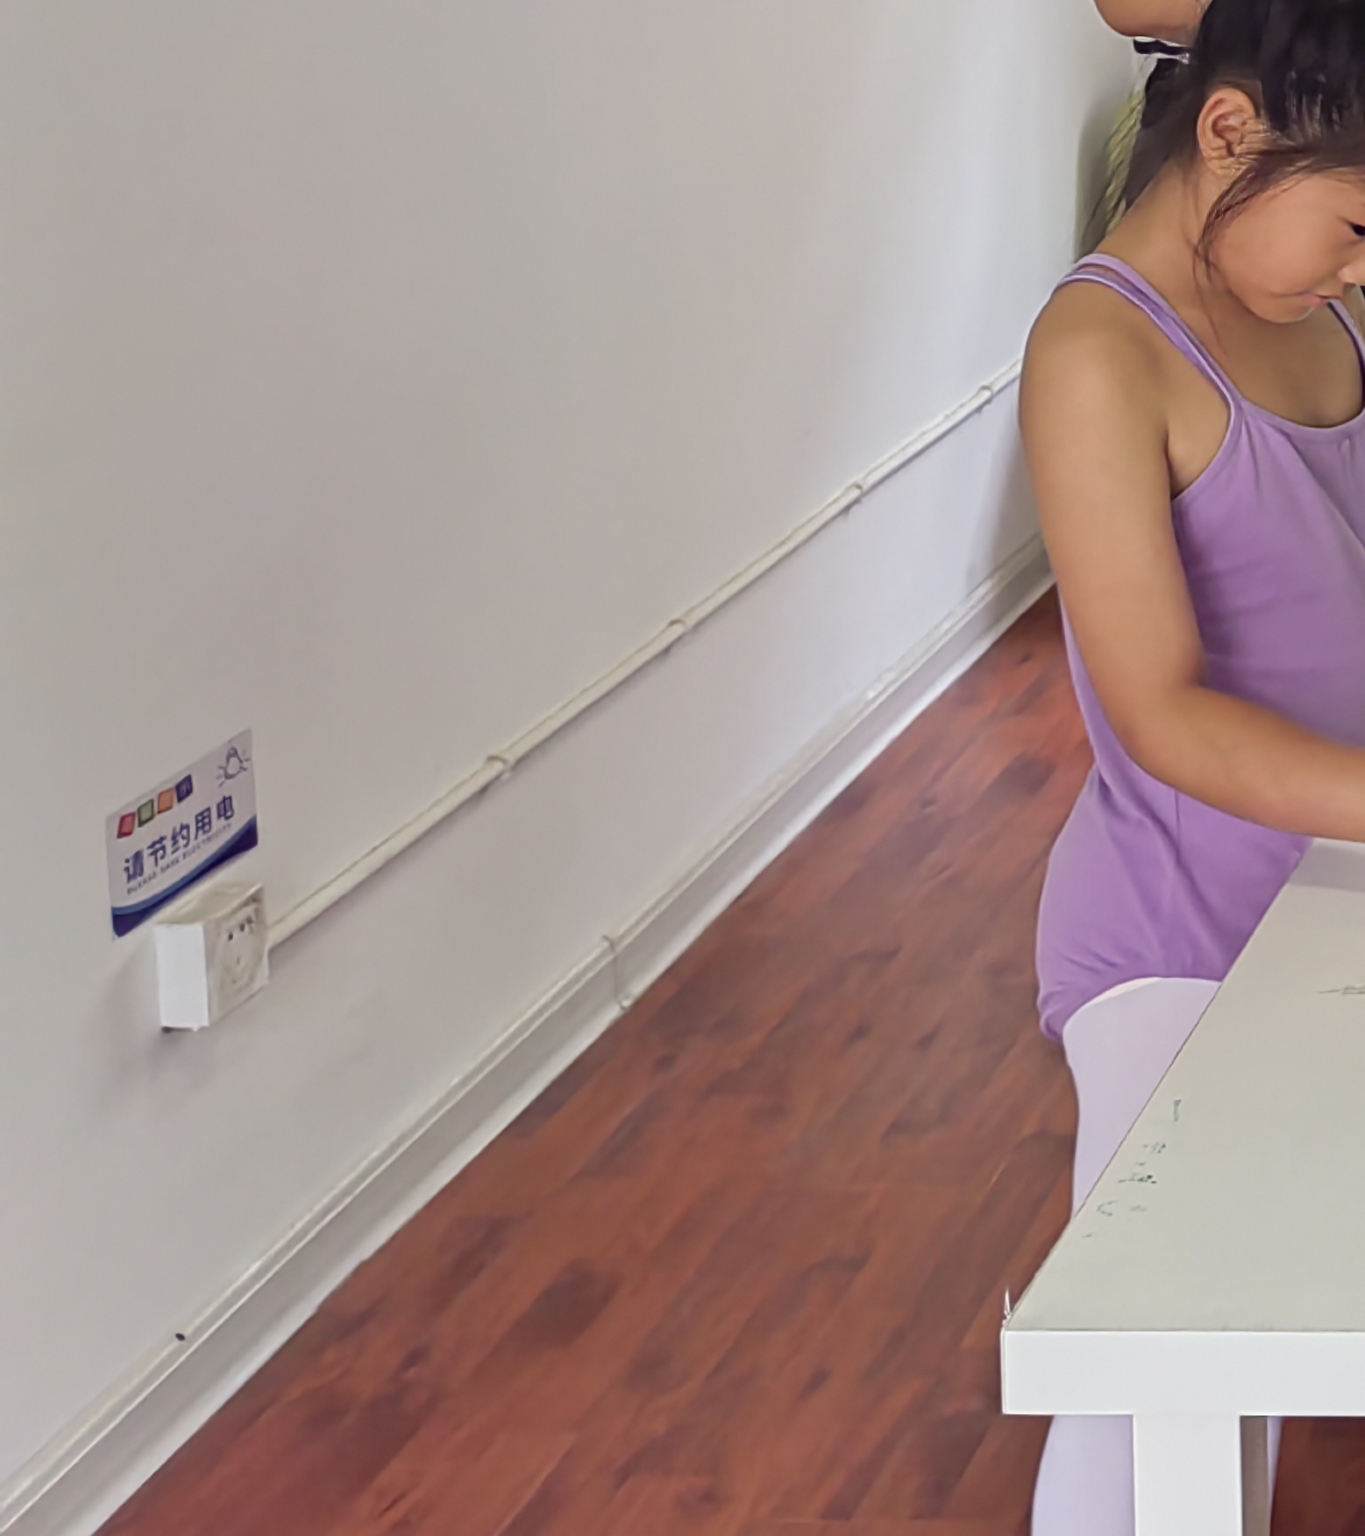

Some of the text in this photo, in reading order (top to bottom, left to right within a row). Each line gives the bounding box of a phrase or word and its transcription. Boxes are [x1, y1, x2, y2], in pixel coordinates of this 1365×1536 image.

[123, 795, 235, 884] 请节约用电
